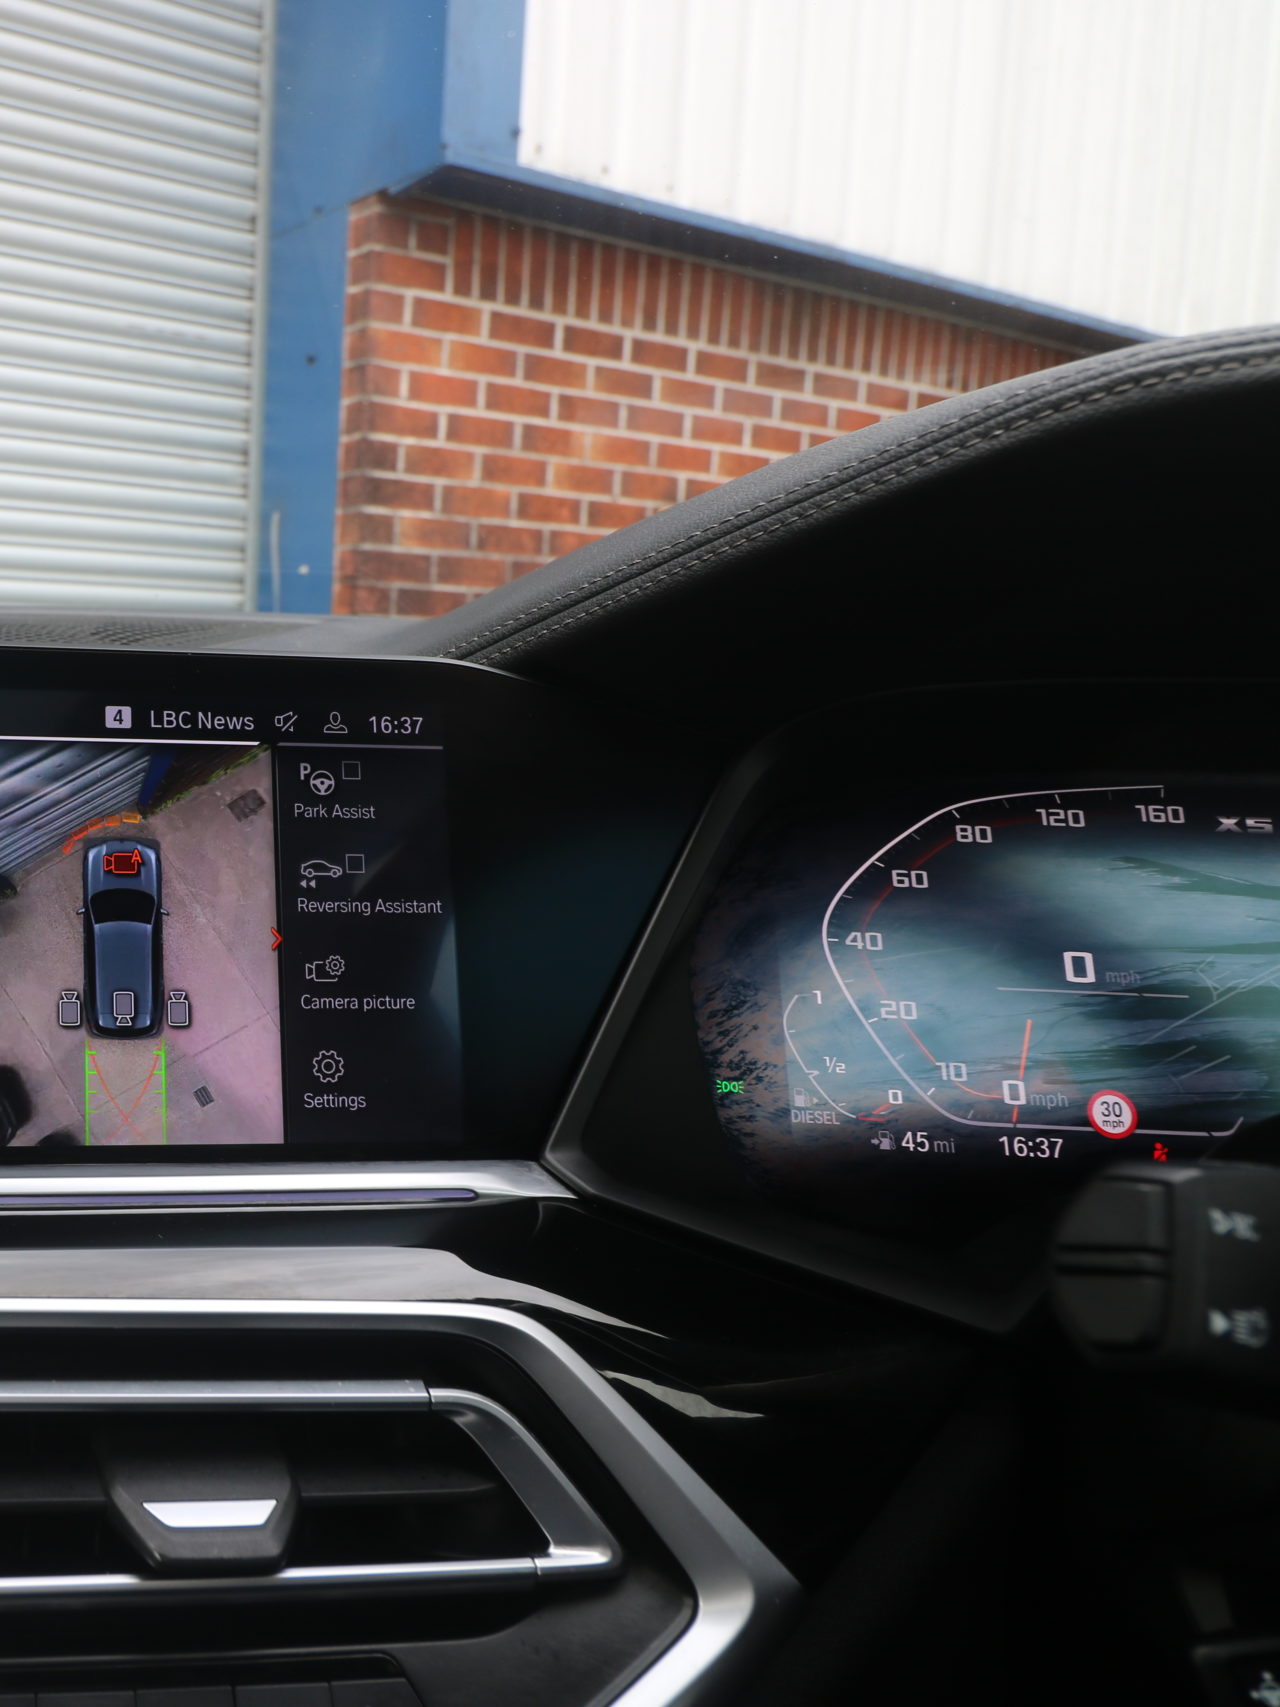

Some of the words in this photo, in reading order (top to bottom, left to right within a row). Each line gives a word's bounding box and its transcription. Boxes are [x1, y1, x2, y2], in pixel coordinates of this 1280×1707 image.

[113, 709, 124, 724] 4
[150, 711, 191, 730] LBC
[198, 712, 255, 731] News
[369, 716, 423, 735] 16:37
[294, 804, 328, 819] Park
[332, 805, 376, 819] Assist
[1035, 808, 1085, 828] 120
[1135, 805, 1185, 824] 160
[1216, 816, 1274, 833] X5
[955, 824, 992, 844] 80
[891, 869, 928, 889] 60
[297, 898, 371, 916] Reversing
[375, 899, 443, 914] Assistant
[845, 932, 883, 950] 40
[1063, 951, 1096, 983] 0
[1105, 969, 1140, 986] mph
[301, 995, 358, 1010] Camera
[363, 995, 416, 1013] picture
[812, 990, 822, 1004] 1
[879, 1000, 918, 1020] 20
[935, 1062, 968, 1082] 10
[304, 1093, 367, 1111] Settings
[888, 1089, 903, 1104] 0
[1001, 1079, 1026, 1105] 0
[1030, 1092, 1069, 1109] mph
[791, 1109, 840, 1125] DIESEL
[1100, 1101, 1123, 1117] 30
[1102, 1119, 1125, 1128] mph
[901, 1131, 929, 1152] 45
[934, 1136, 956, 1153] mi
[998, 1135, 1064, 1159] 16:37
